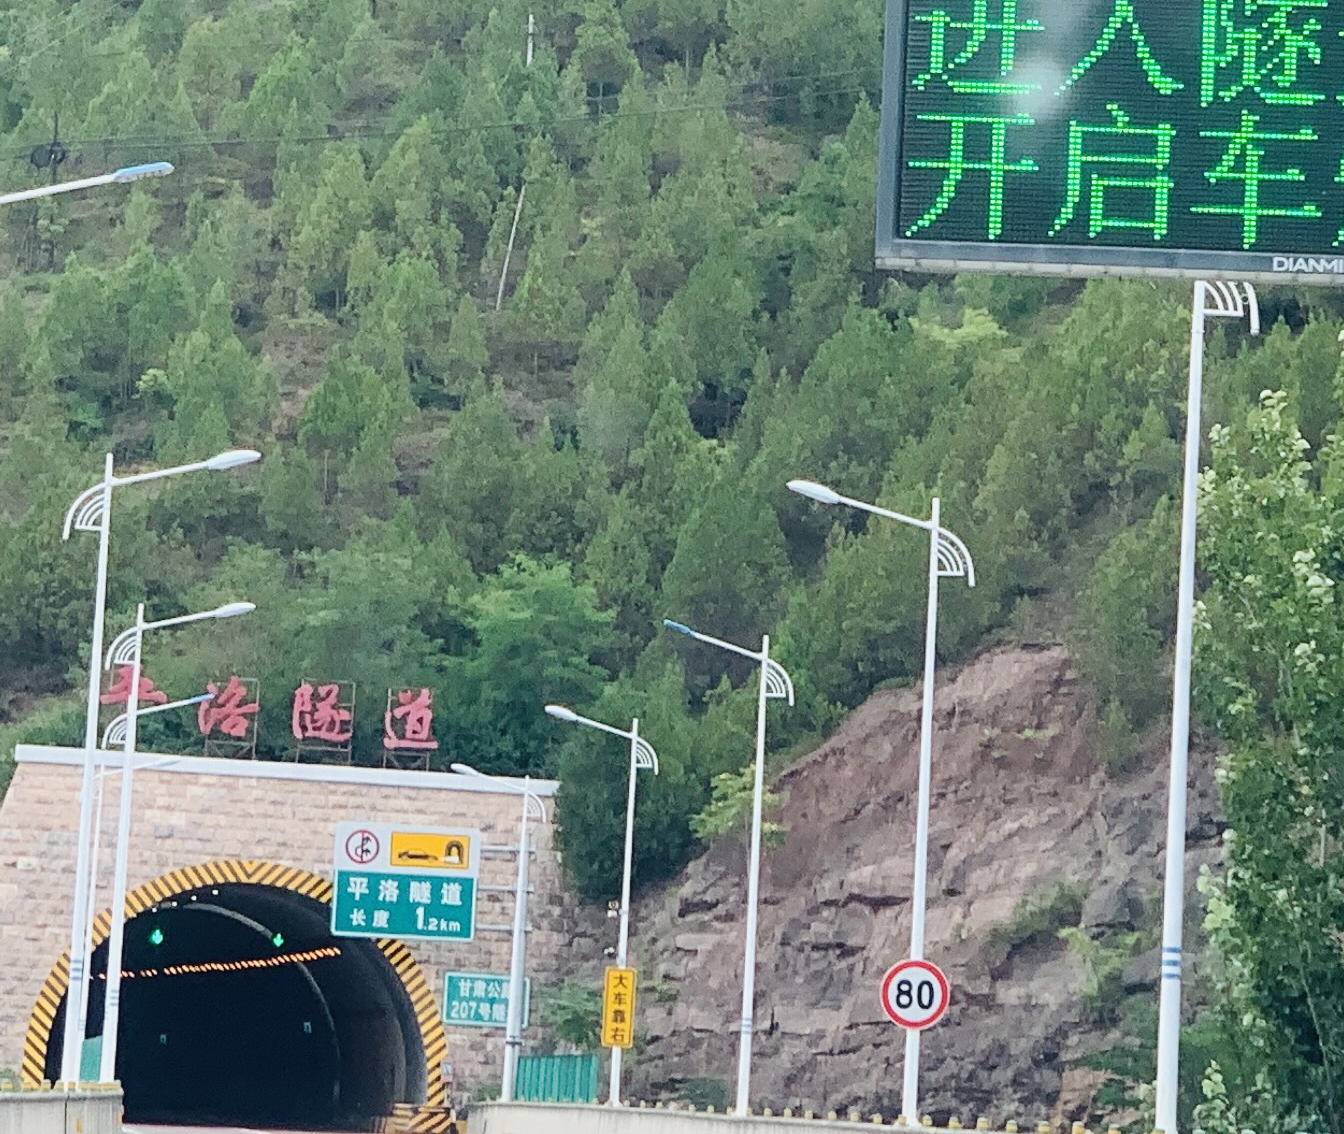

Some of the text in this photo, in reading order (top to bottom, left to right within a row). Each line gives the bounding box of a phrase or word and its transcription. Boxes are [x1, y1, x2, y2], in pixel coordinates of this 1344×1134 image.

[347, 876, 463, 906] 平洛隧道
[349, 908, 390, 929] 长度
[610, 973, 629, 1043] 大车靠右
[896, 979, 934, 1009] 80
